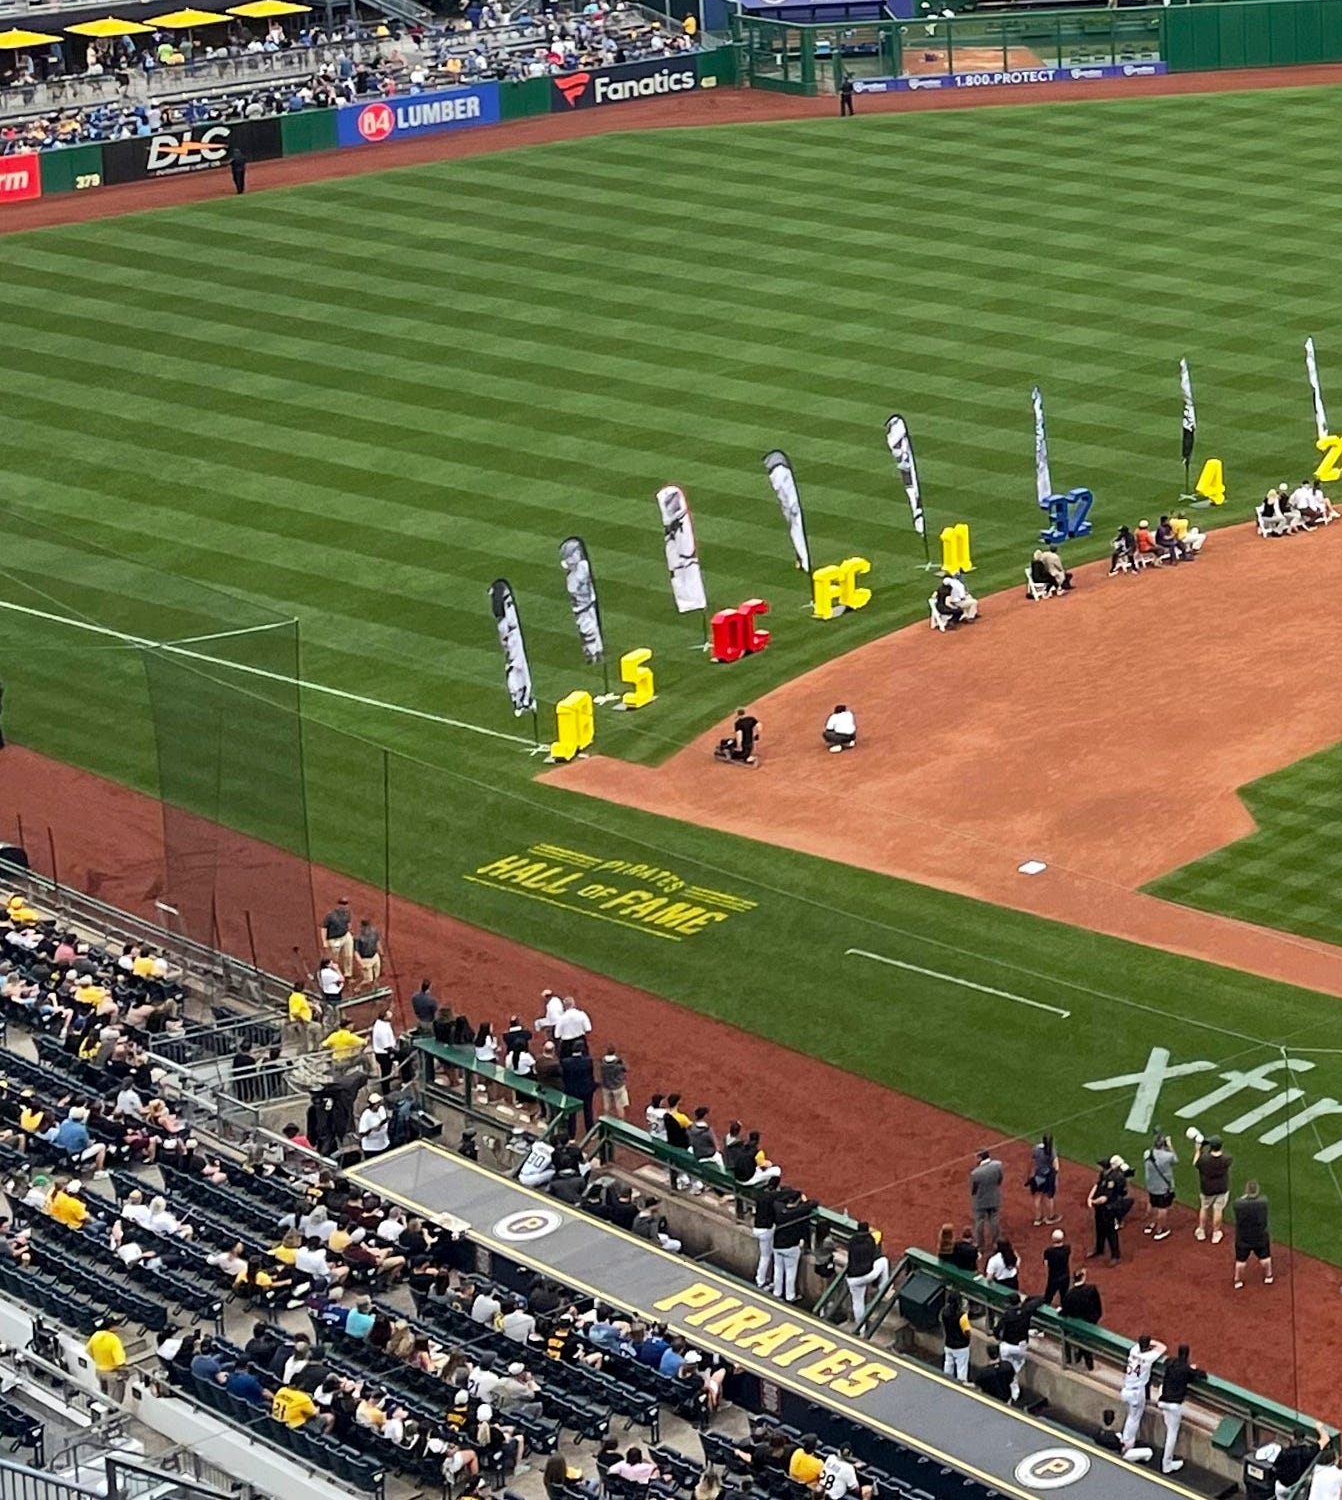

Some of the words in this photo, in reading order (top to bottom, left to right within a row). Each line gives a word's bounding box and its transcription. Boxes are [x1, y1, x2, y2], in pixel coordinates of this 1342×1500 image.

[594, 67, 695, 104] Fanatics
[955, 70, 1056, 87] 1.800.PROTECT
[362, 110, 387, 135] 84
[397, 96, 481, 129] LUMBER
[146, 127, 232, 172] DLC
[1195, 458, 1226, 505] 4
[940, 524, 972, 575] 11
[812, 556, 872, 620] FC
[620, 647, 655, 708] 5
[476, 855, 584, 895] HALL
[576, 883, 618, 899] OF
[598, 890, 729, 936] FAME
[575, 860, 686, 894] PIRATES
[653, 1281, 899, 1399] PIRATES
[273, 1401, 287, 1420] 21
